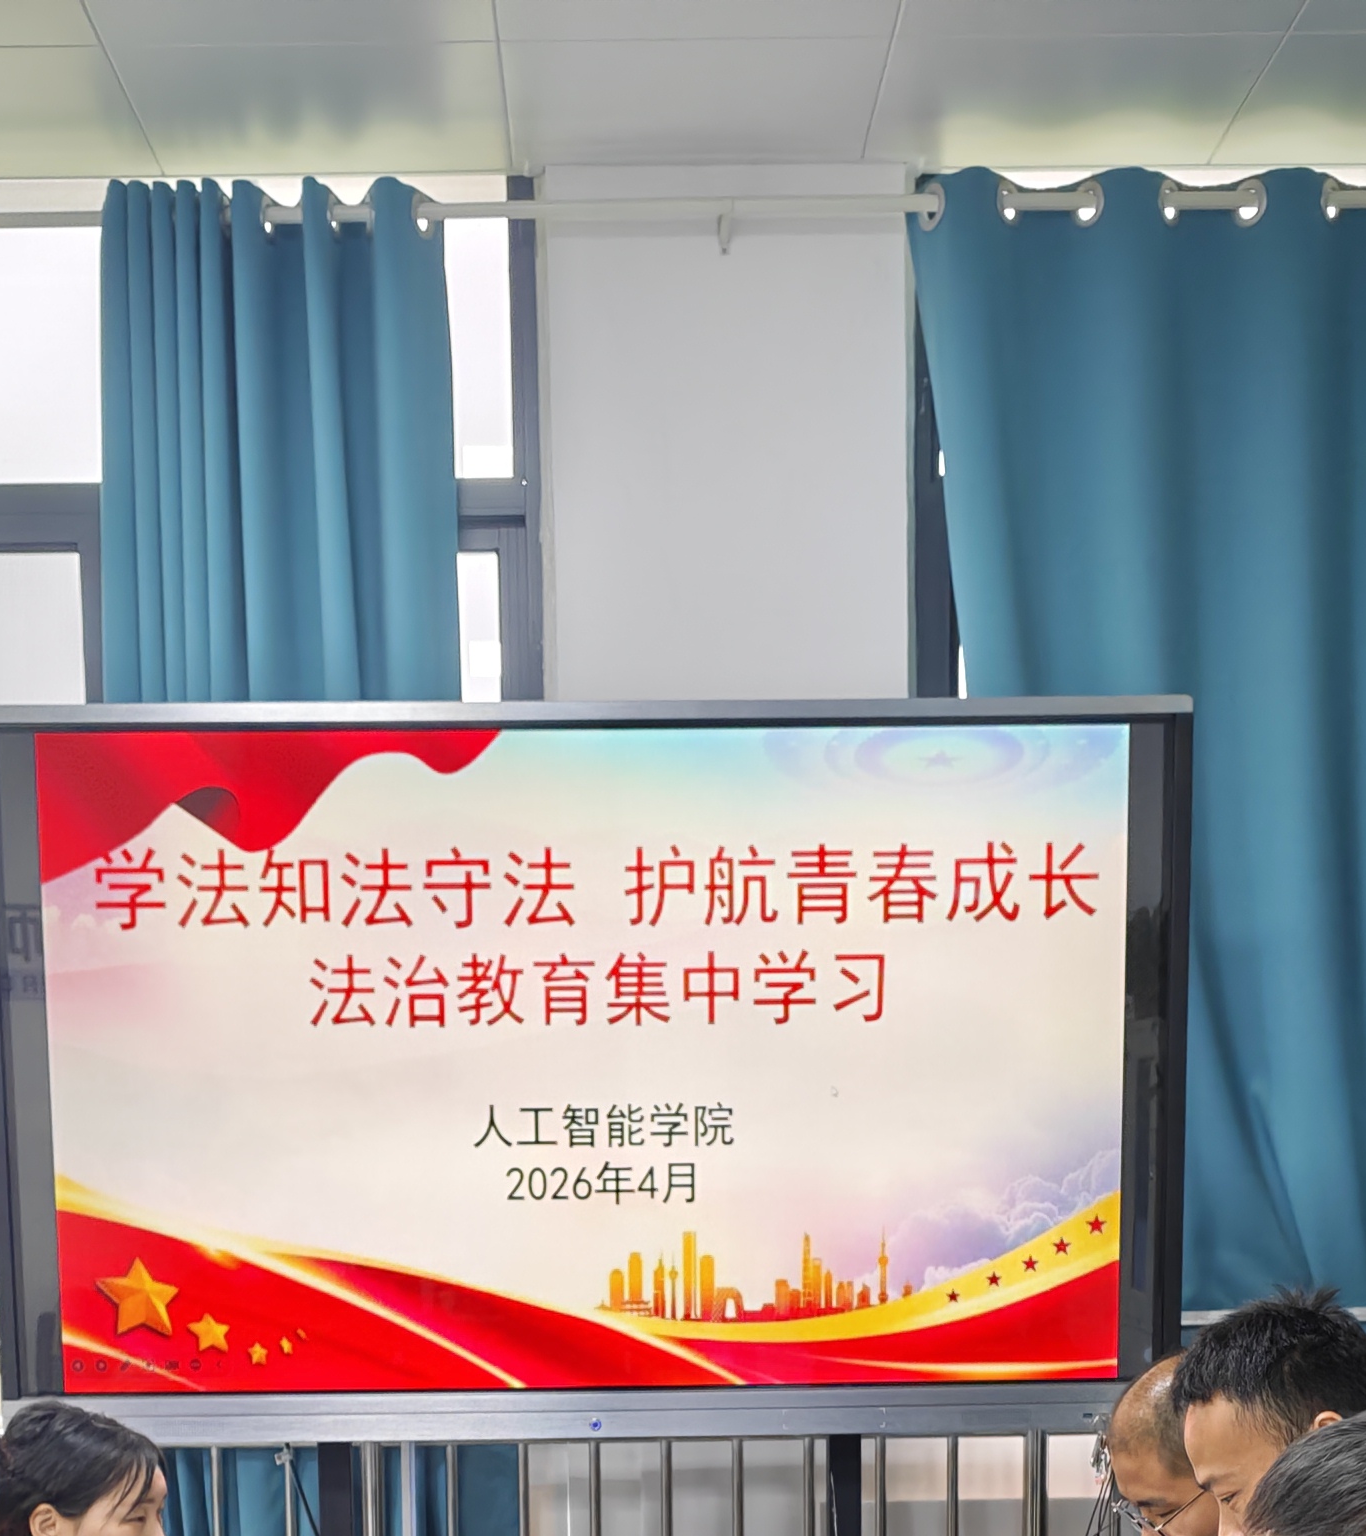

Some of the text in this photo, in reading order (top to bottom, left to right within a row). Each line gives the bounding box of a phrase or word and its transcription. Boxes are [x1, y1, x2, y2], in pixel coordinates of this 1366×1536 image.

[94, 840, 1100, 931] 学法知法守法 护航青春成长
[309, 949, 886, 1027] 法治教育集中学习
[473, 1102, 735, 1148] 人工智能学院
[506, 1161, 696, 1205] 2026年4月
